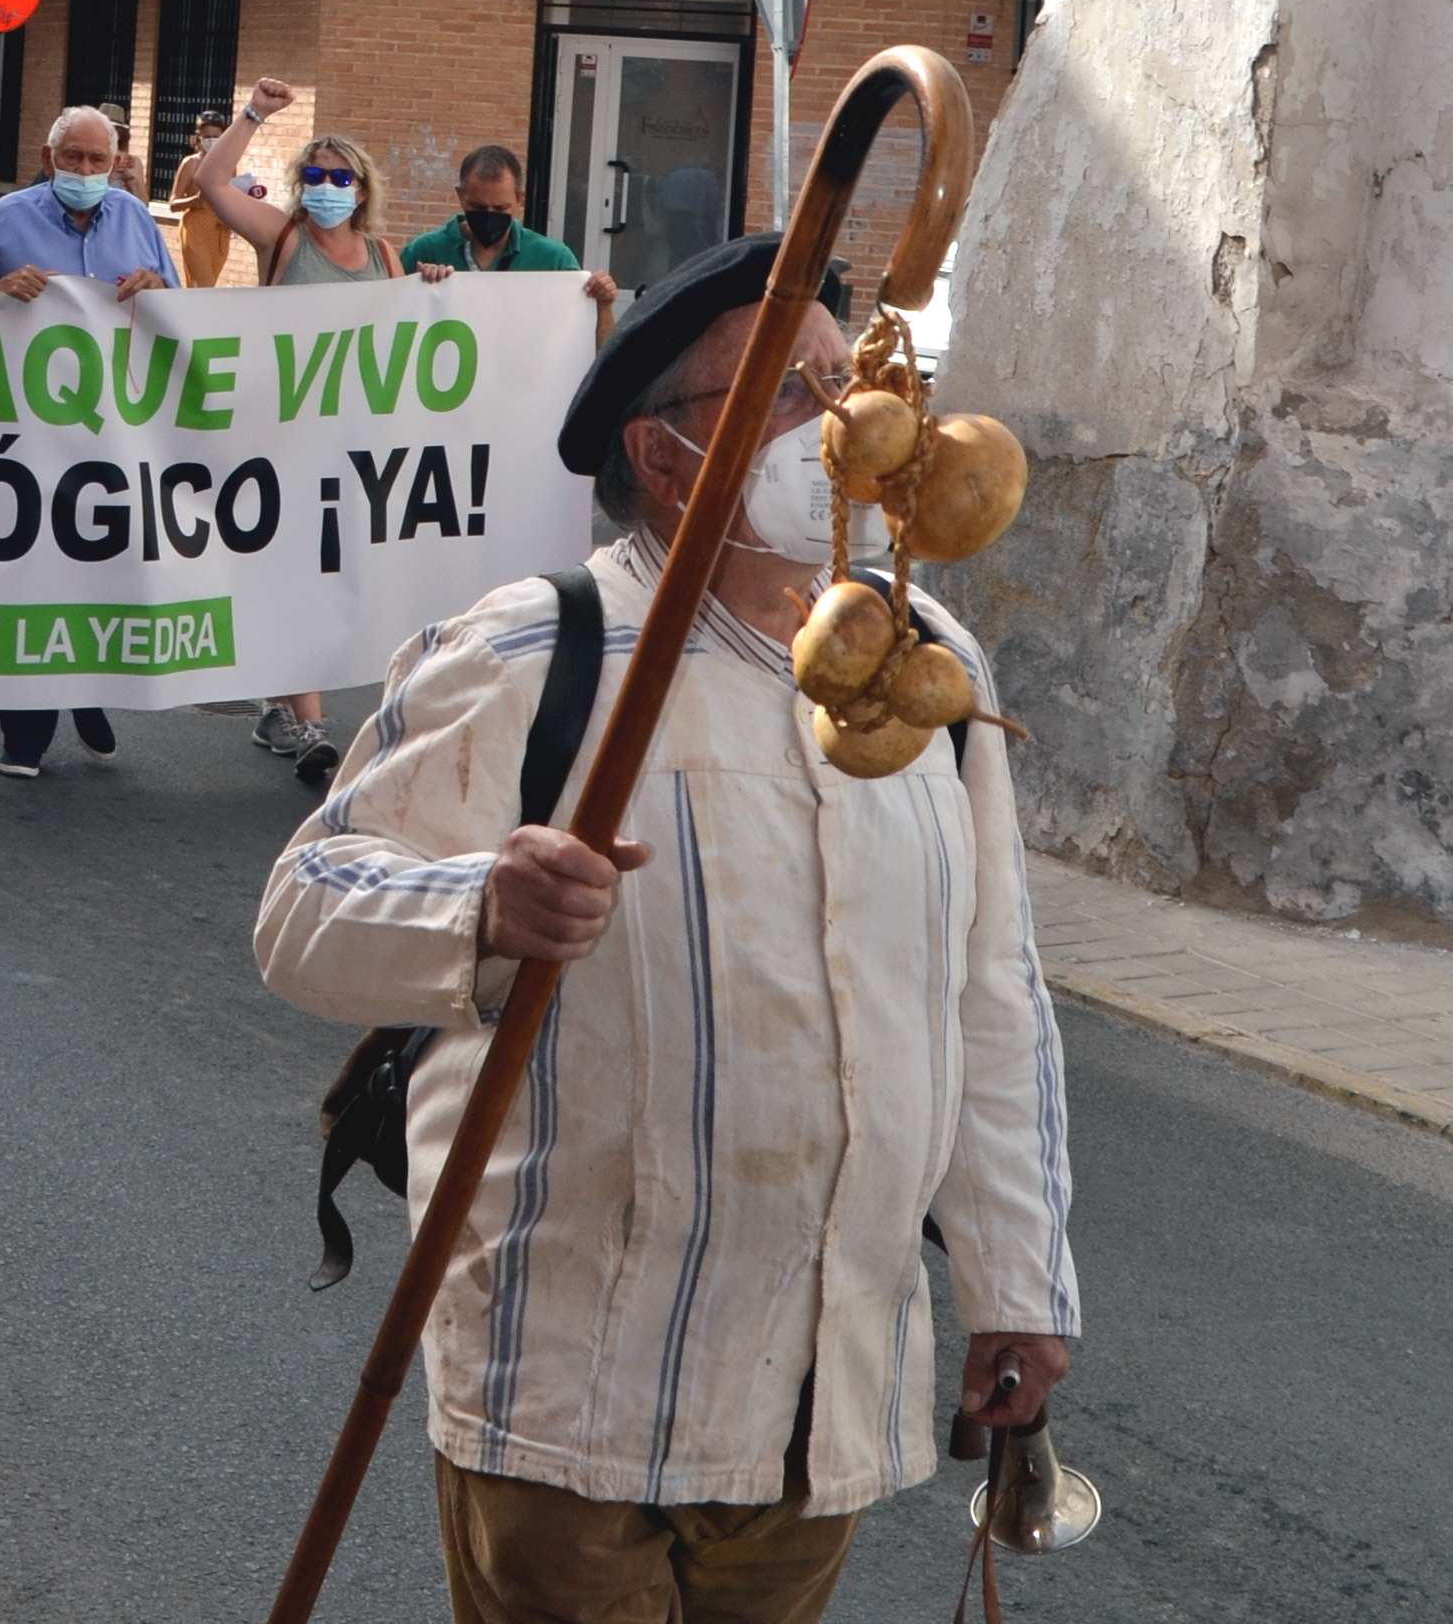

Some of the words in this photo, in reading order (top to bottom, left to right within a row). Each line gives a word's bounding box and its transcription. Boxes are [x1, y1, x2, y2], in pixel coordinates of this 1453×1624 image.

[274, 320, 478, 422] VIVO
[320, 444, 490, 574] ¡YA!
[16, 617, 76, 665] LA
[87, 611, 218, 665] YEDRA
